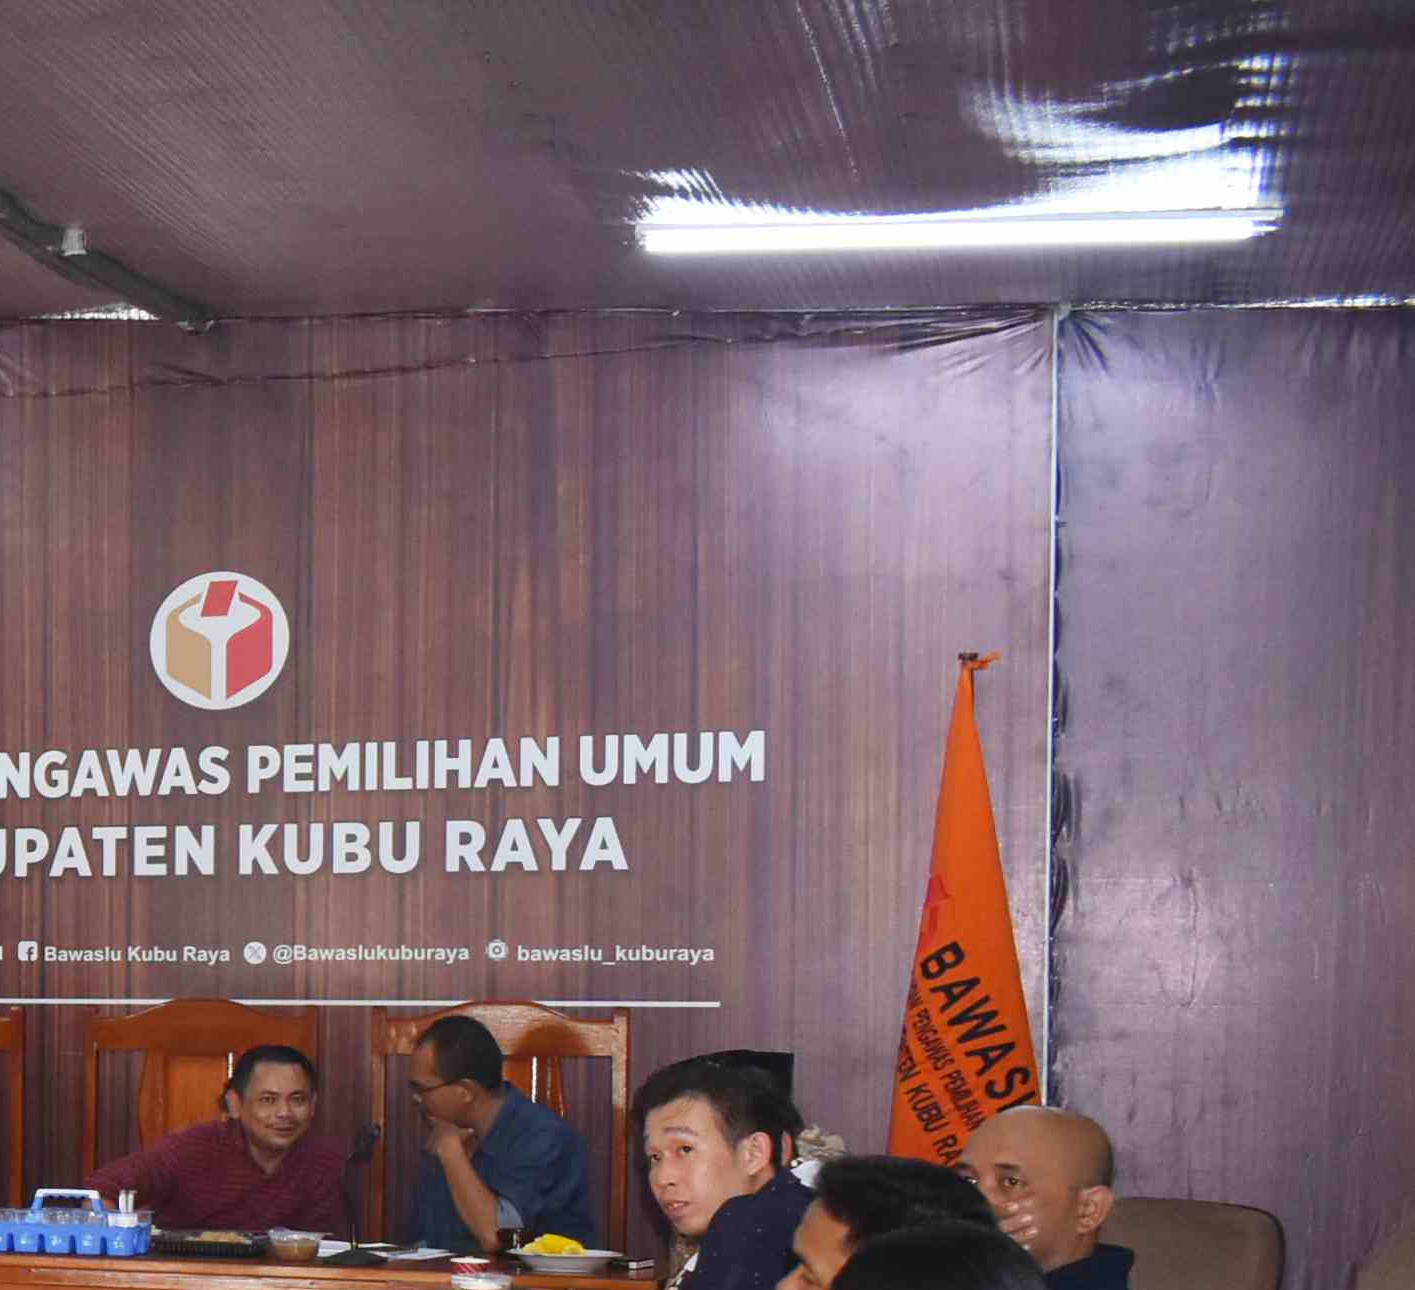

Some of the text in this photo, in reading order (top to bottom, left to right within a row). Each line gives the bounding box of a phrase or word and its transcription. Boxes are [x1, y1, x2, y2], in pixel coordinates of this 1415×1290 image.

[247, 736, 560, 794] PEMILIHAN
[579, 730, 766, 786] UMUM
[238, 821, 420, 875] KUBU
[445, 816, 629, 872] RAYA
[43, 945, 230, 966] Bawaslu Kubu Raya
[272, 944, 470, 965] @Bawaslukuburaya
[517, 944, 715, 966] bawaslu_kuburaya
[903, 1082, 951, 1134] KUBU
[932, 1133, 964, 1168] RA
